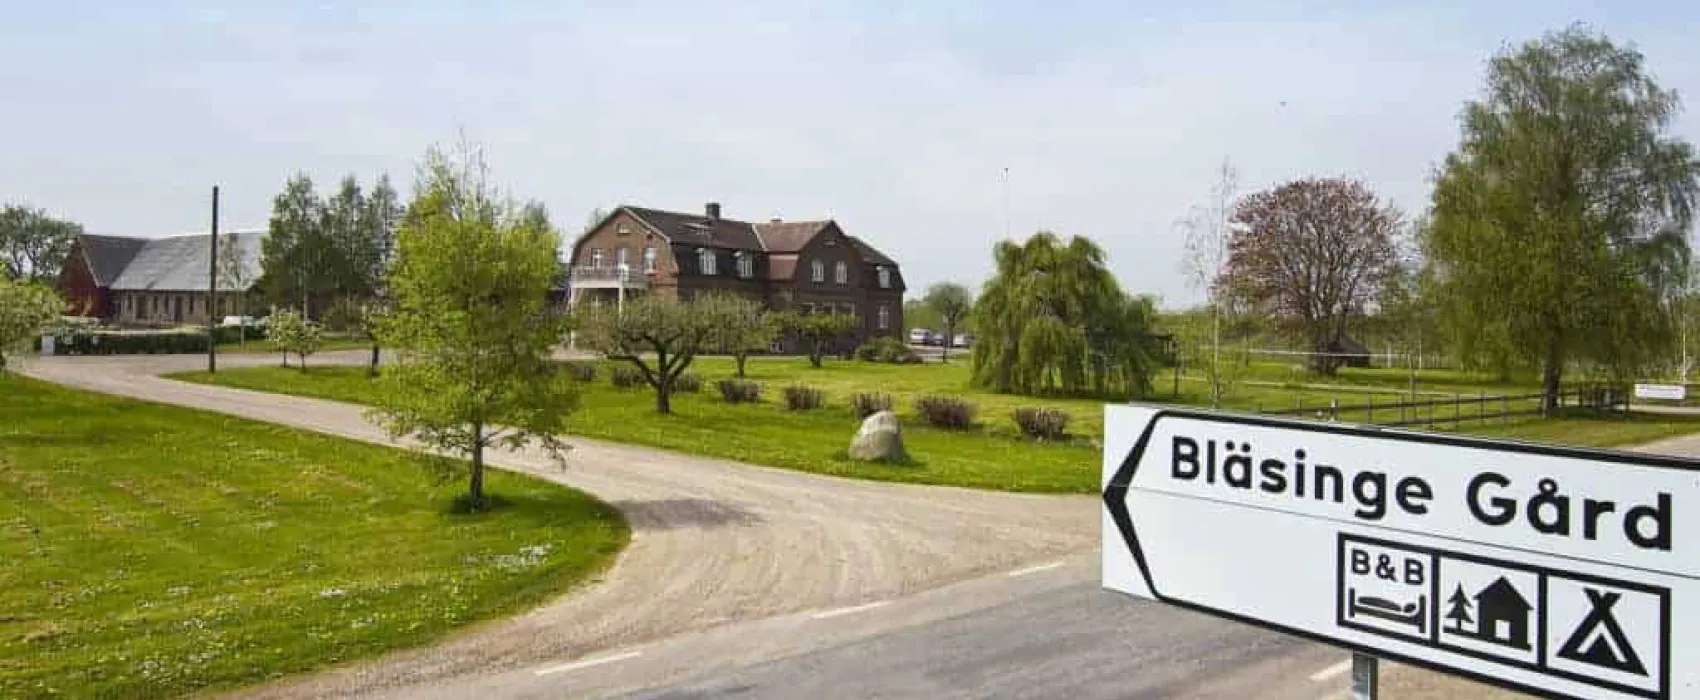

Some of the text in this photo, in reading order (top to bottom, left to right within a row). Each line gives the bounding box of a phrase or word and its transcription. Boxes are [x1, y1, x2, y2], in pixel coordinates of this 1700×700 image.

[1171, 435, 1673, 552] Bläsinge Gård
[1350, 548, 1426, 586] B&B
